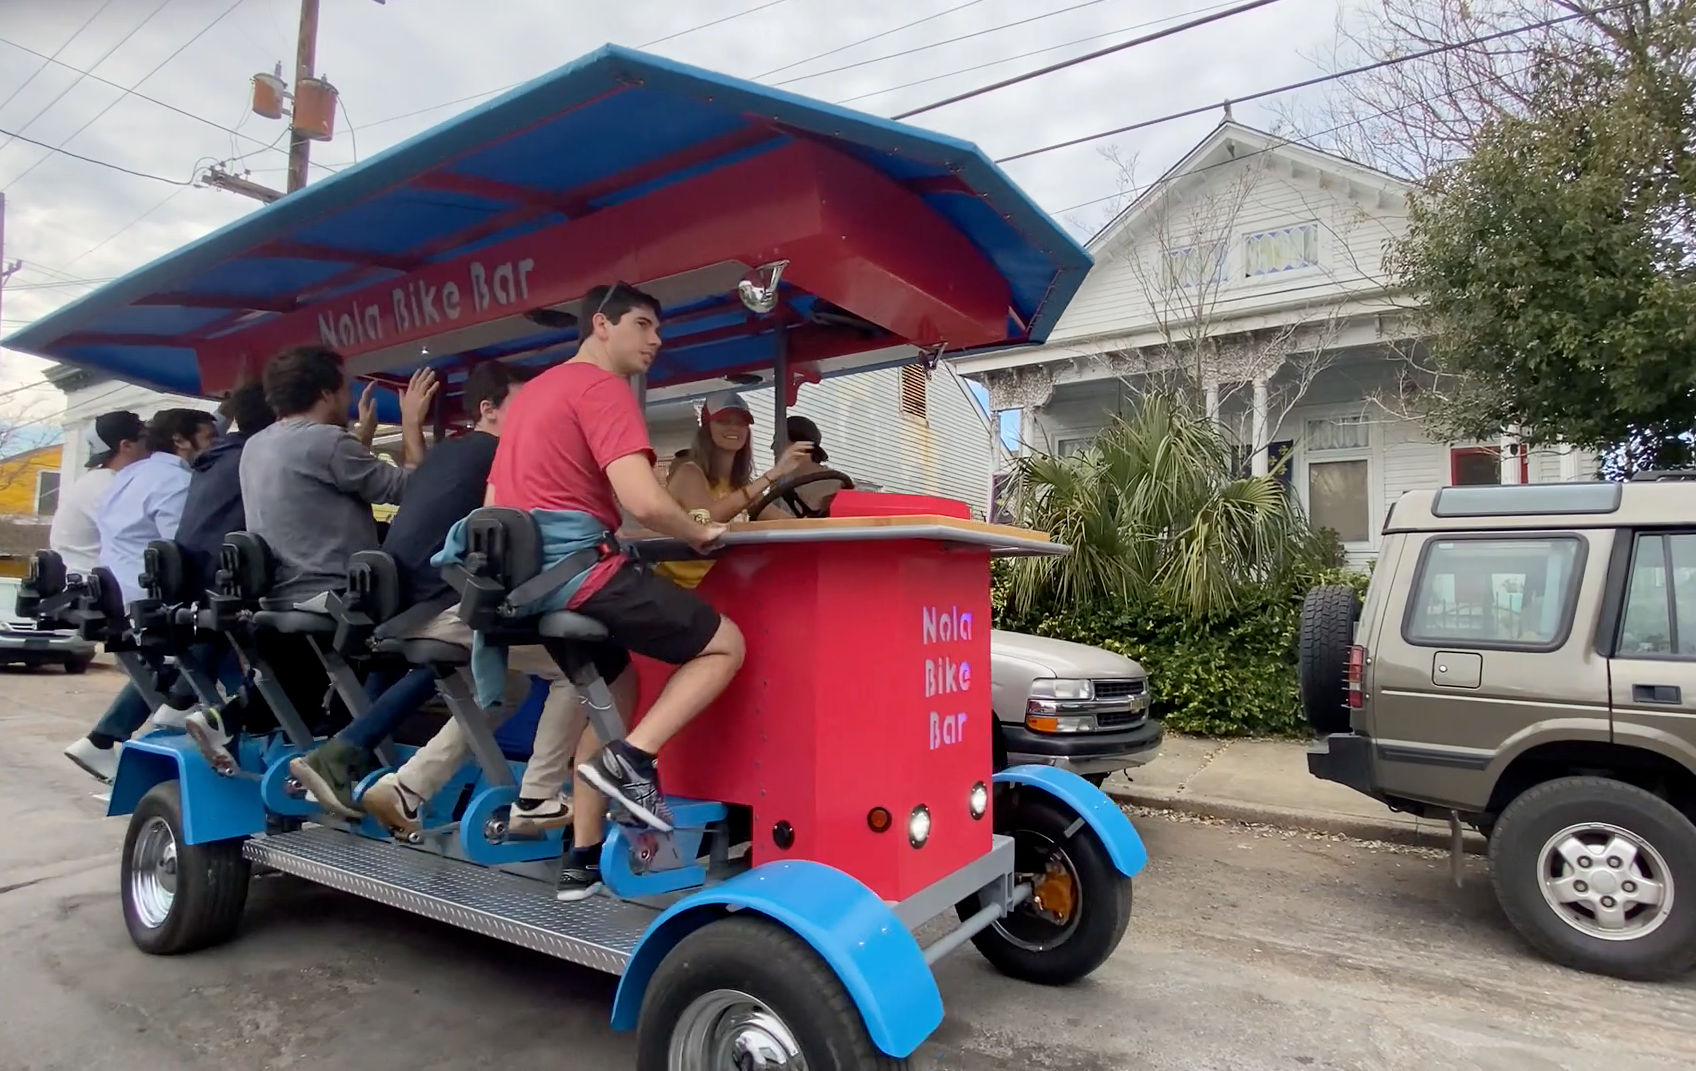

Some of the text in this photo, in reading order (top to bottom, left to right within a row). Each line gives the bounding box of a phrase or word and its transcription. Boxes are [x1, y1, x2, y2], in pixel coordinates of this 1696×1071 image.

[318, 258, 535, 349] Nola Bike Bar
[922, 605, 973, 645] Nola
[925, 656, 971, 698] Bike
[929, 711, 967, 750] Bar
